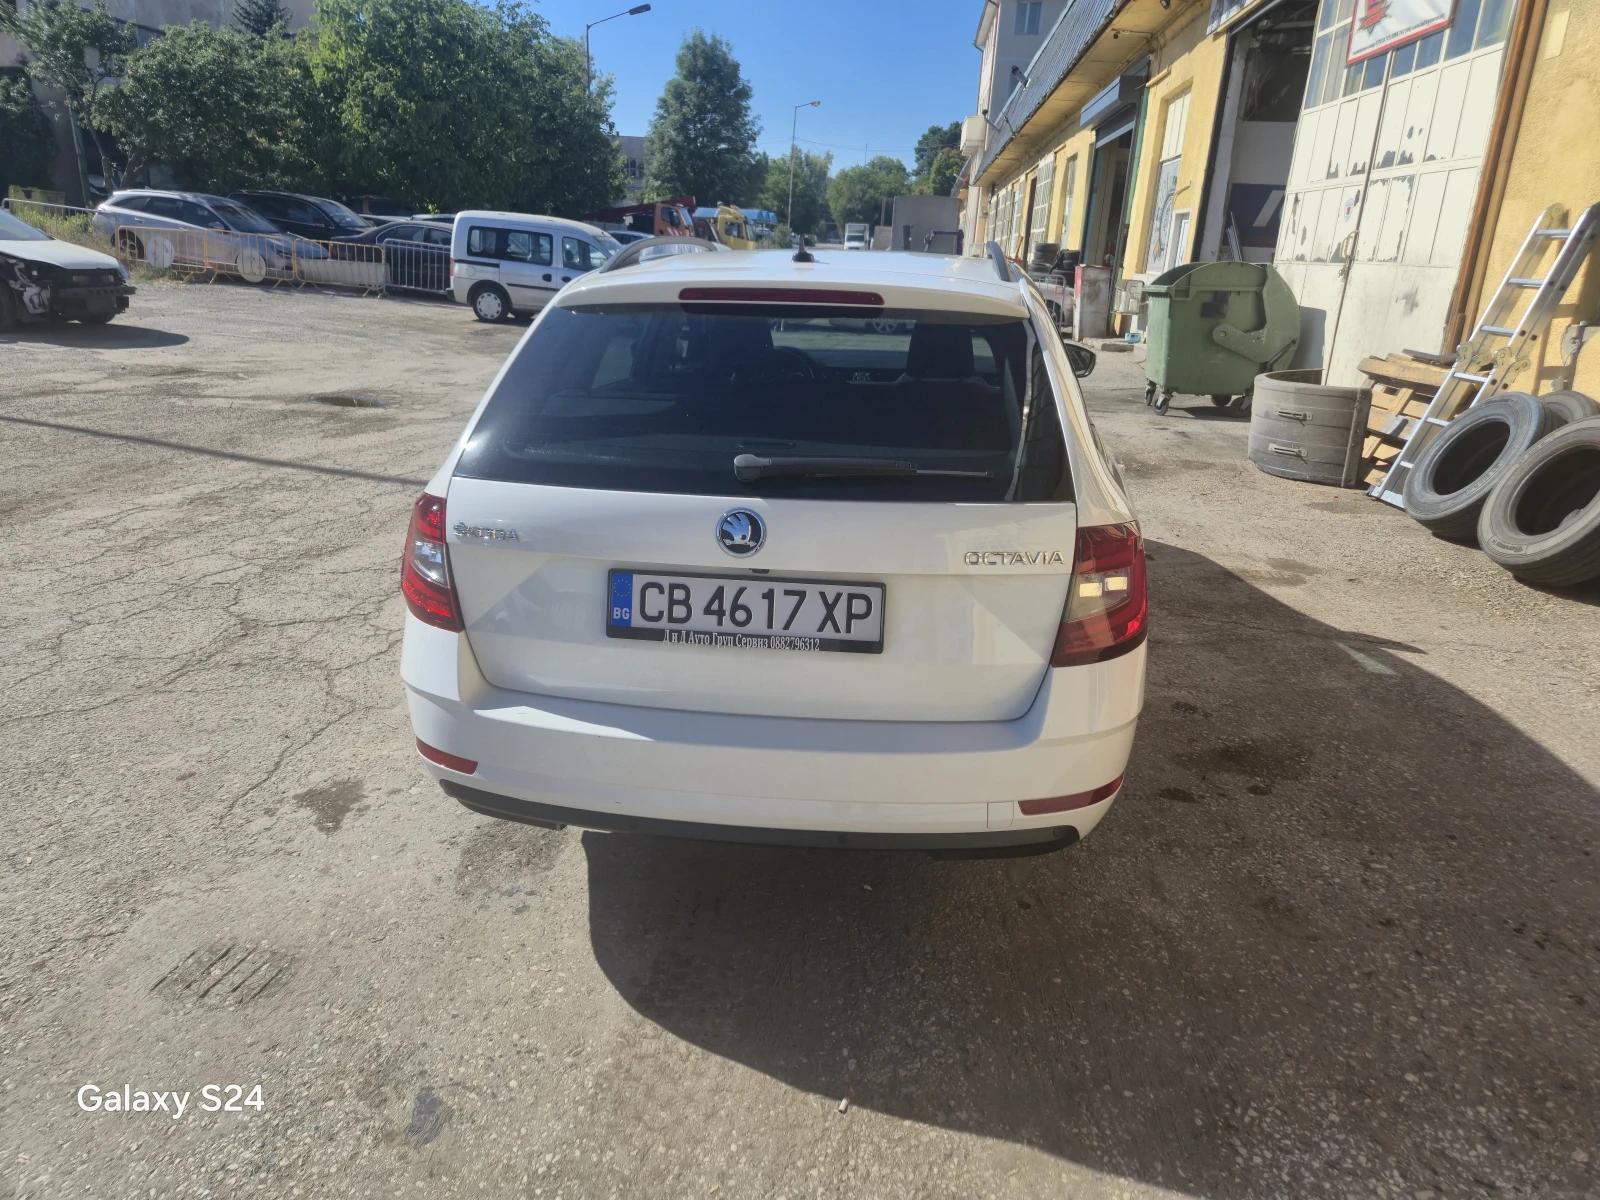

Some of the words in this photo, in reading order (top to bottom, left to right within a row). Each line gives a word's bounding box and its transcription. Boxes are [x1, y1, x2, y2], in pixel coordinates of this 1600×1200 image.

[964, 551, 1065, 565] OCTAVIA
[613, 607, 630, 620] BG
[703, 585, 807, 631] 4617
[688, 630, 710, 647] Ауто
[712, 632, 734, 650] Груп
[736, 633, 768, 650] Сервиз
[770, 635, 820, 652] 0882796312
